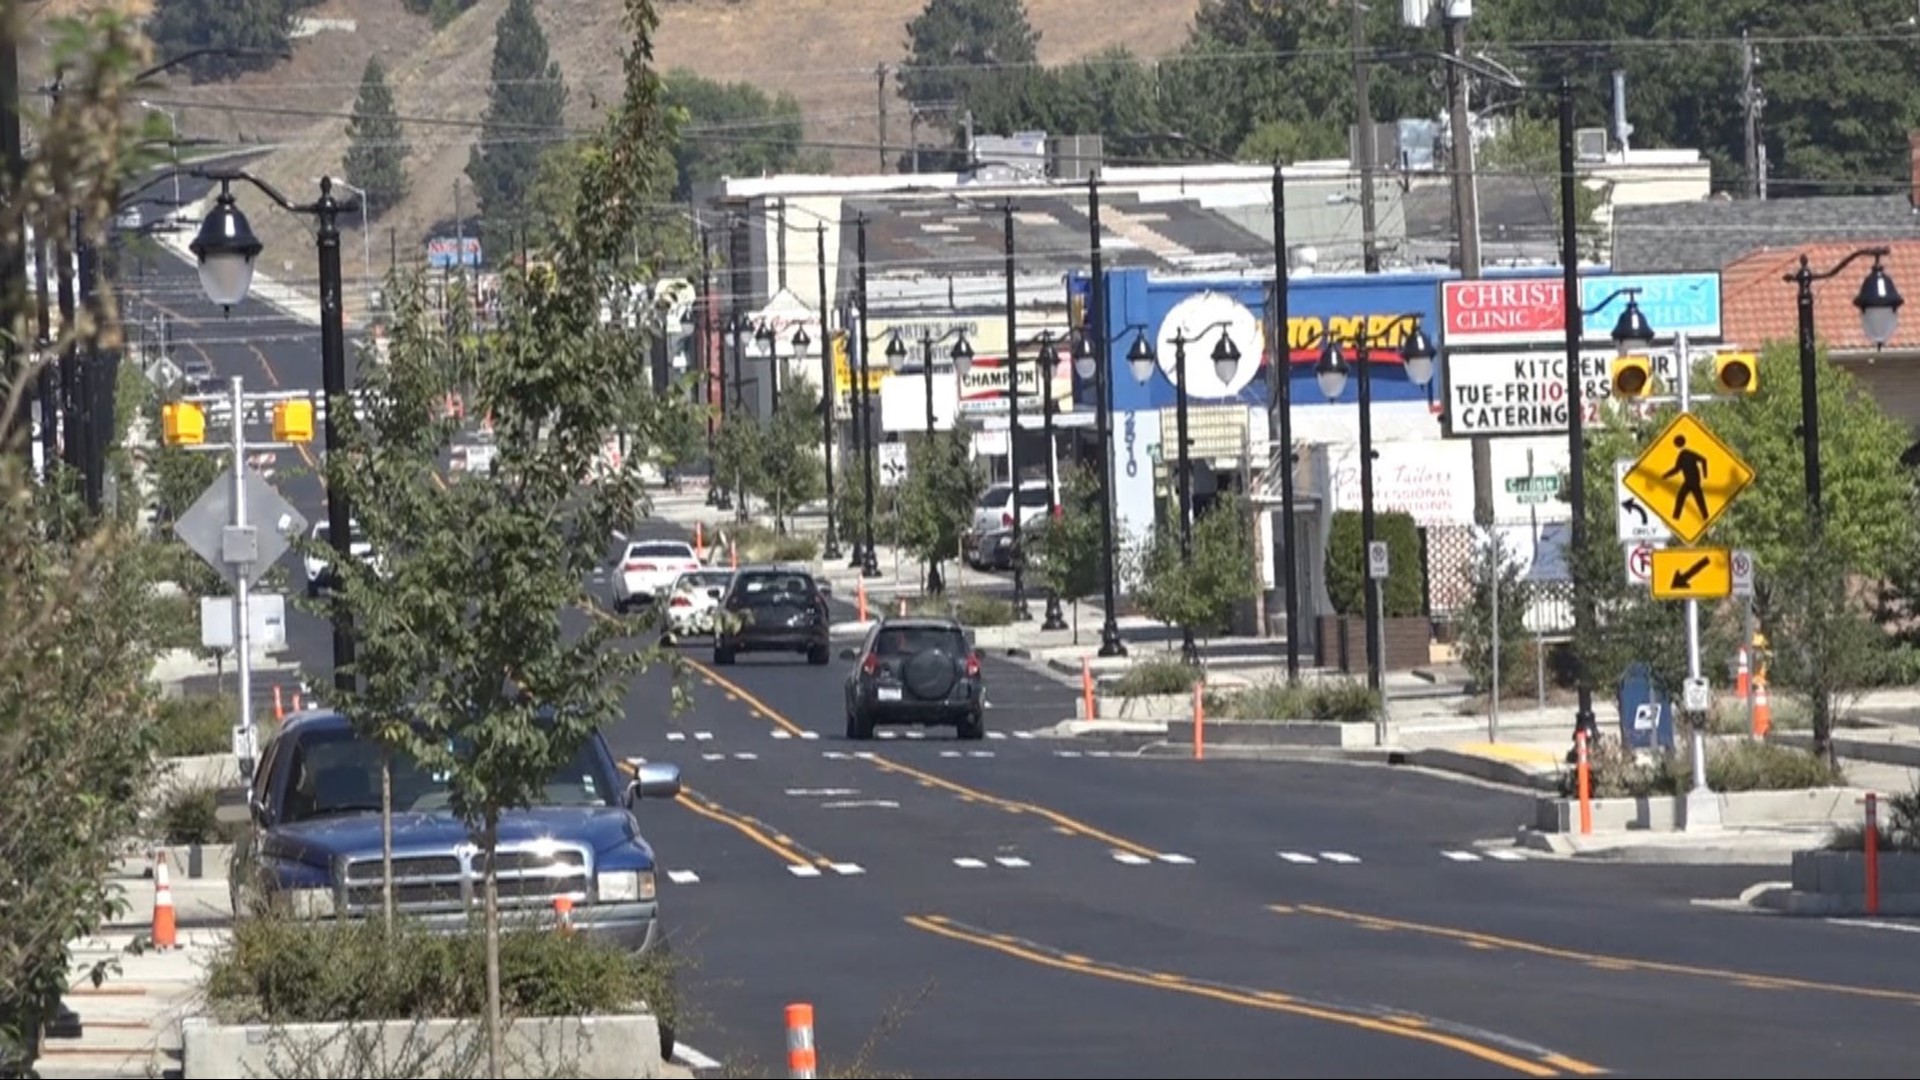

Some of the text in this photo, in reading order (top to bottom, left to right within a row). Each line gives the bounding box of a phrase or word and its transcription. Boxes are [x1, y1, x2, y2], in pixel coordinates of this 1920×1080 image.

[1456, 284, 1563, 308] CHRIST
[1456, 309, 1529, 329] CLINIC
[962, 370, 1034, 388] CHAMPON
[1514, 356, 1606, 380] KITCEN
[1462, 403, 1568, 428] CATERING
